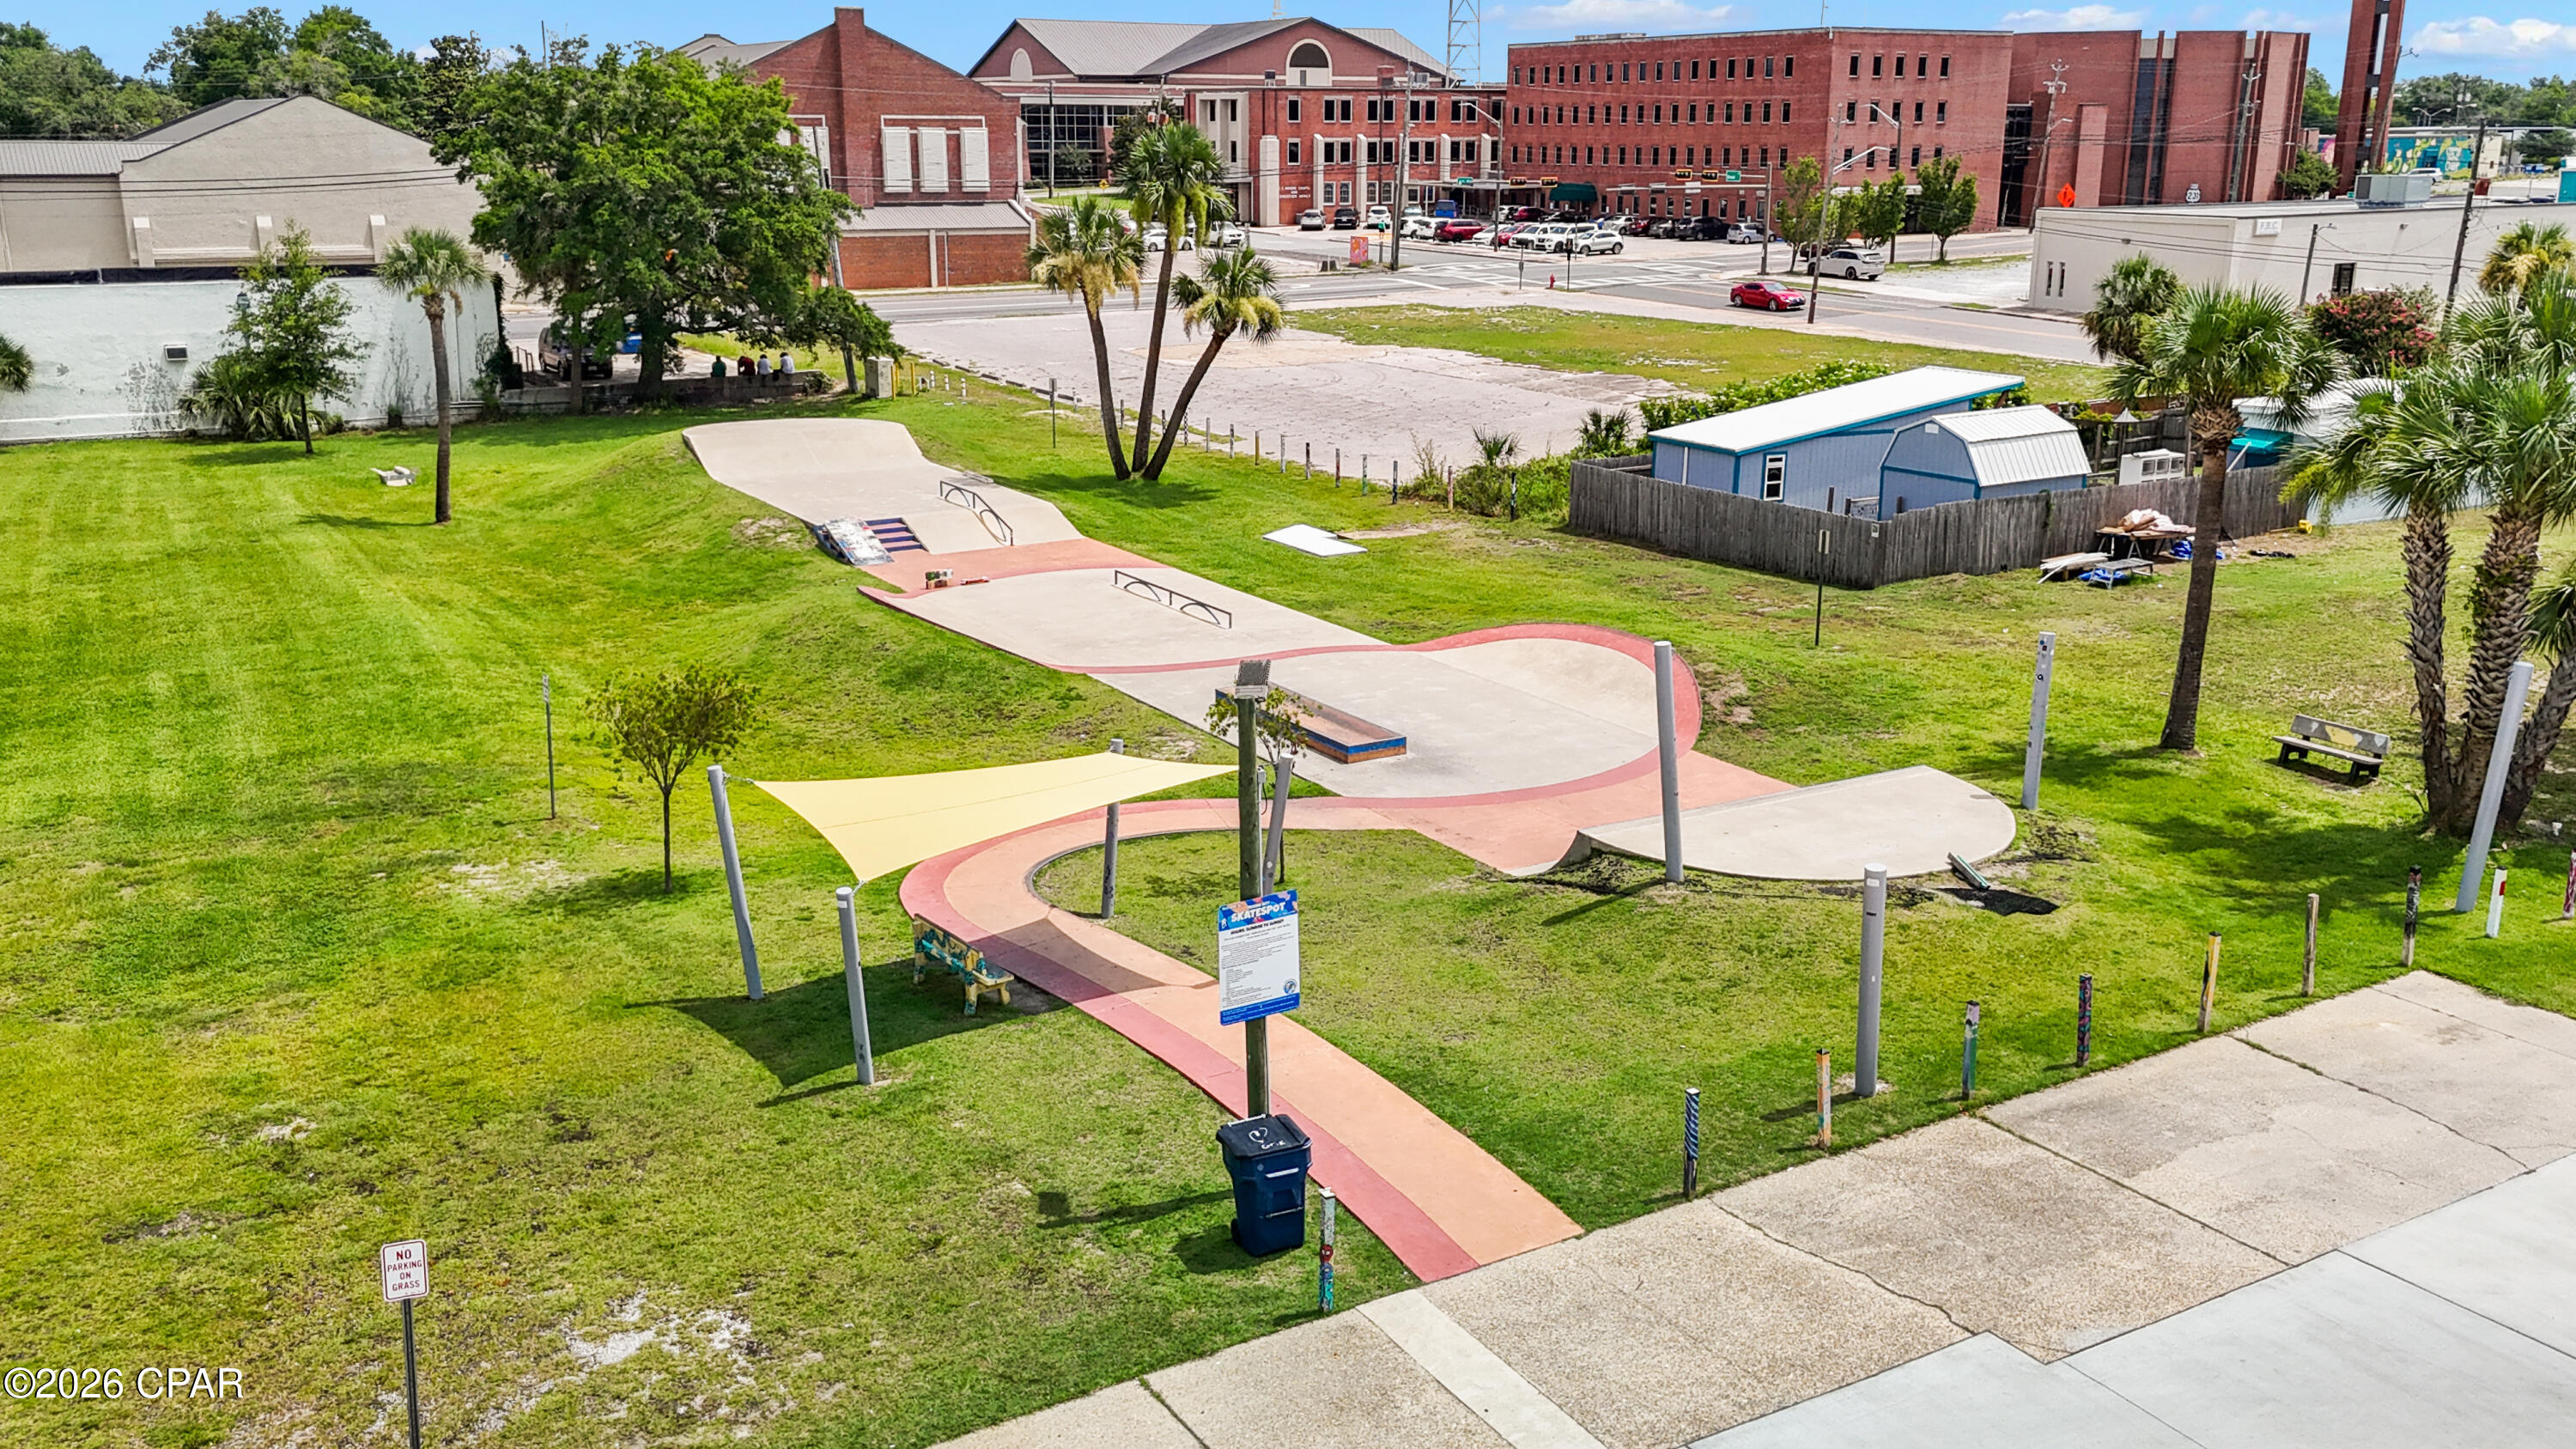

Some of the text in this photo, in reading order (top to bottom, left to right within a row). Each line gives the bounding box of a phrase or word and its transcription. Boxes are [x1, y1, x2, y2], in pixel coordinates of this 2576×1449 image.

[2187, 192, 2199, 200] 231
[1230, 902, 1286, 922] SKATESPOT
[396, 1249, 411, 1261] NO
[387, 1260, 422, 1272] PARKING
[399, 1271, 411, 1280] ON
[392, 1280, 420, 1291] GRASS
